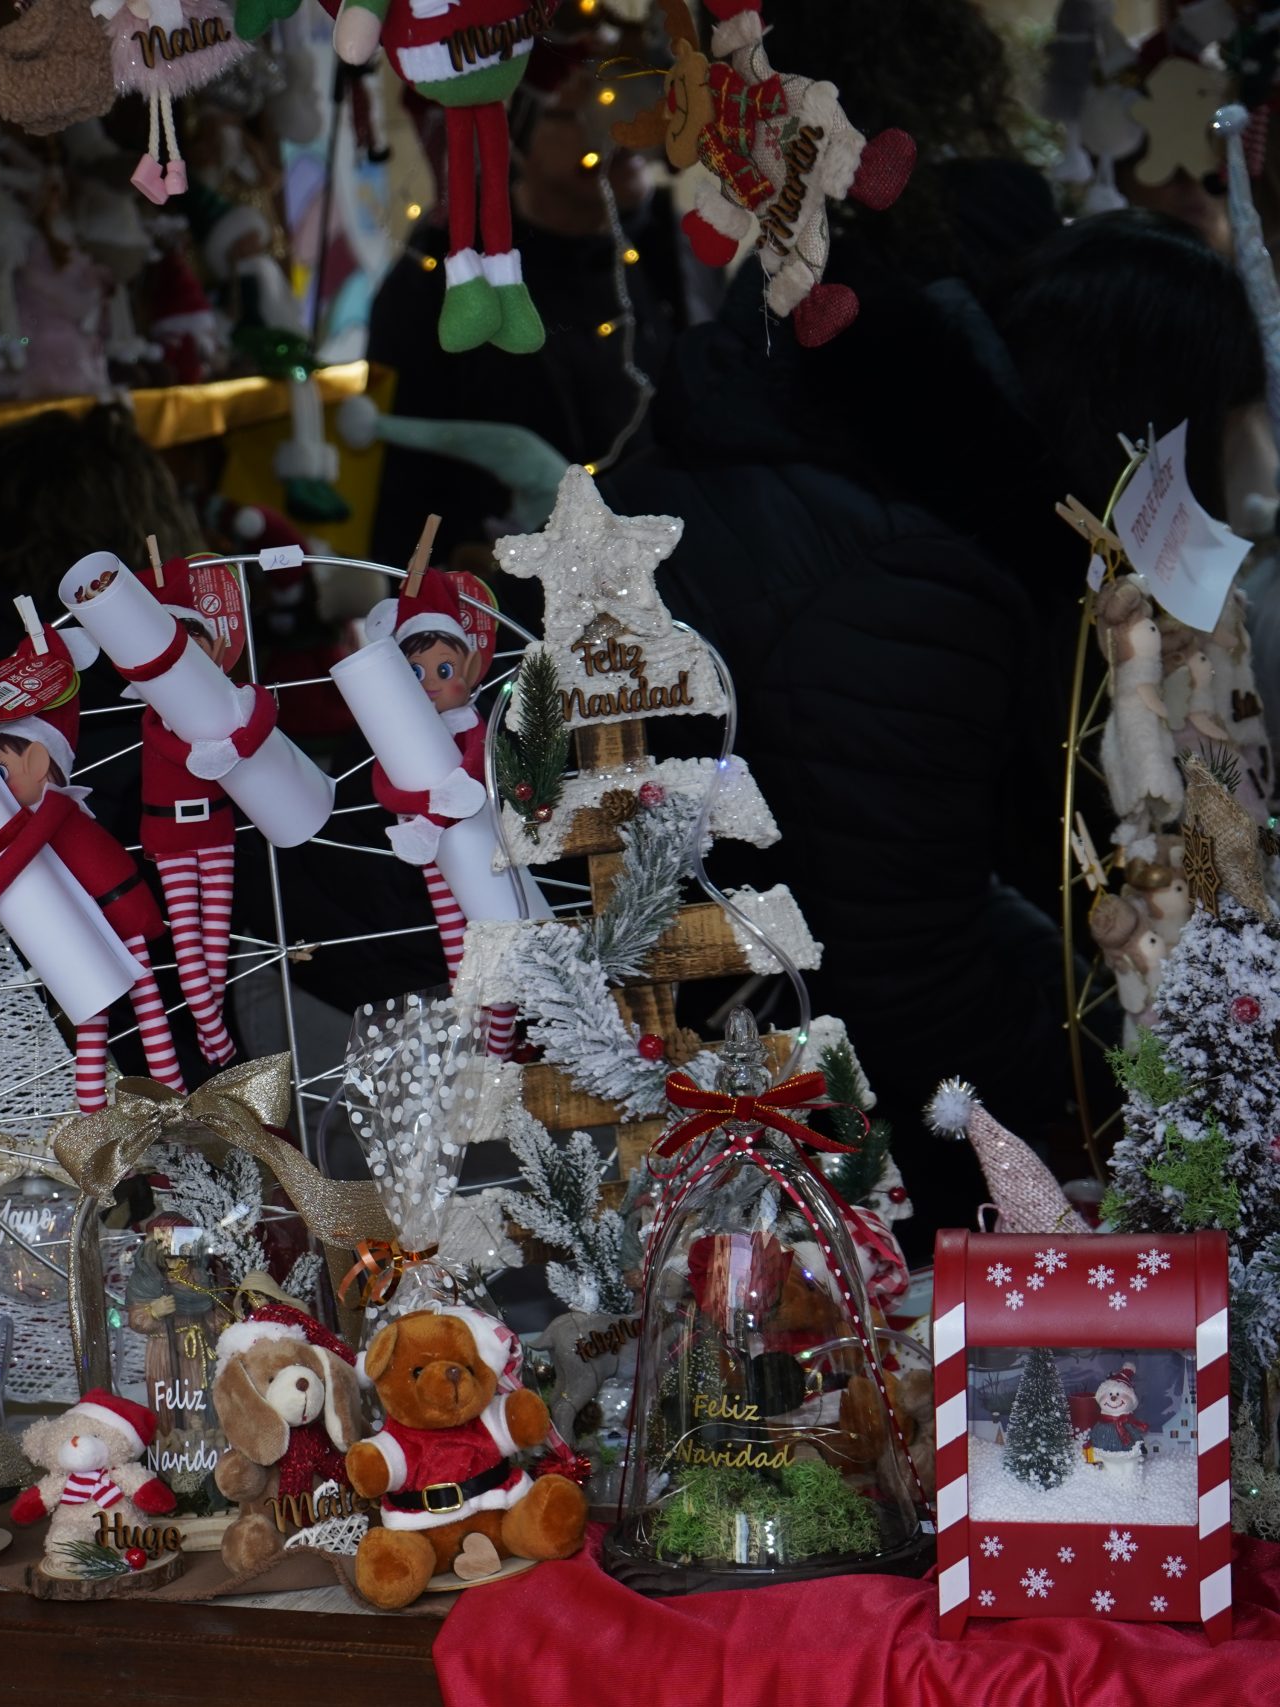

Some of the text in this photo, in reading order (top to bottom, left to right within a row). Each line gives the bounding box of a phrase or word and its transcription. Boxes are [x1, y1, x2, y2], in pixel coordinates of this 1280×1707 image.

[131, 16, 232, 69] Nala
[440, 0, 556, 72] Miguel
[571, 637, 647, 679] Feliz
[557, 670, 694, 722] Navidad
[155, 1379, 207, 1412] Feliz
[692, 1394, 760, 1421] Feliz
[147, 1440, 232, 1472] Navida
[677, 1439, 795, 1470] Navidad
[92, 1511, 186, 1560] Hugo
